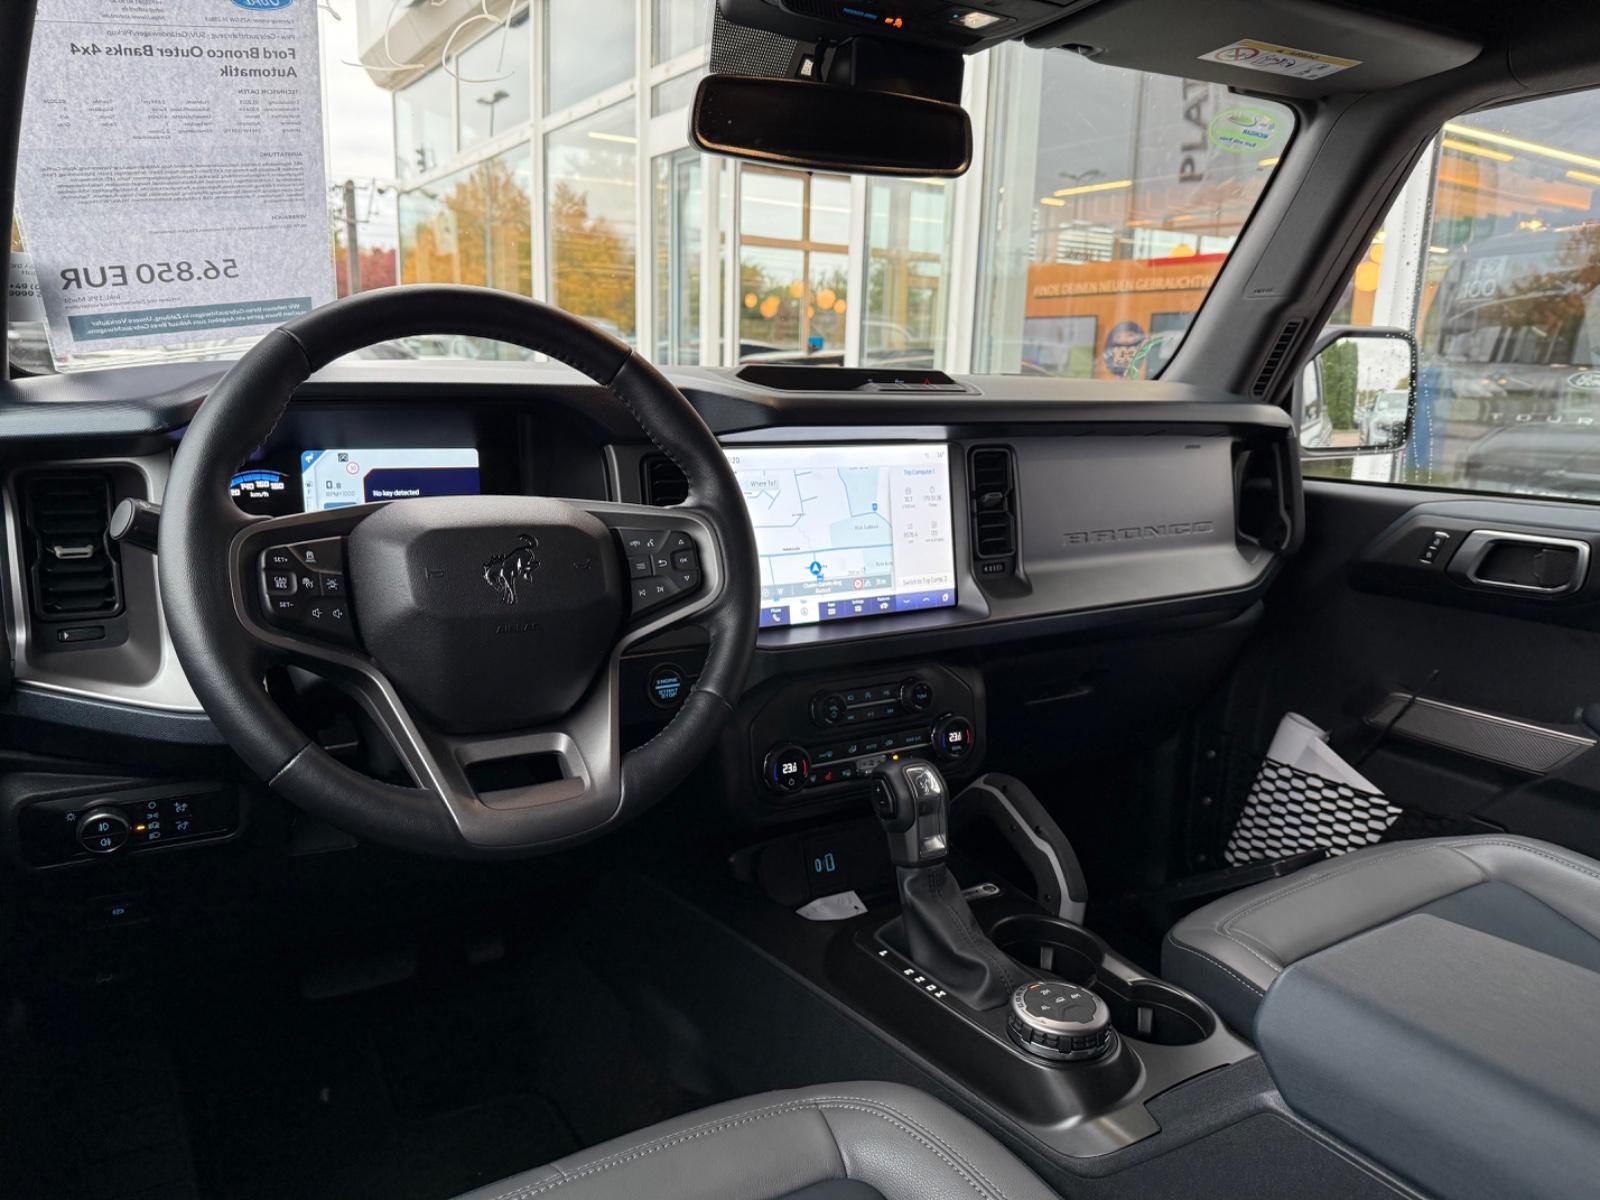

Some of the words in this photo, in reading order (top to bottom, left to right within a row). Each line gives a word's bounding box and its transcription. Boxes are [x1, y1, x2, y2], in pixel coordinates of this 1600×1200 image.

[240, 482, 255, 490] 140
[382, 490, 393, 498] key
[394, 489, 420, 497] detected
[1063, 520, 1214, 546] BRONCO
